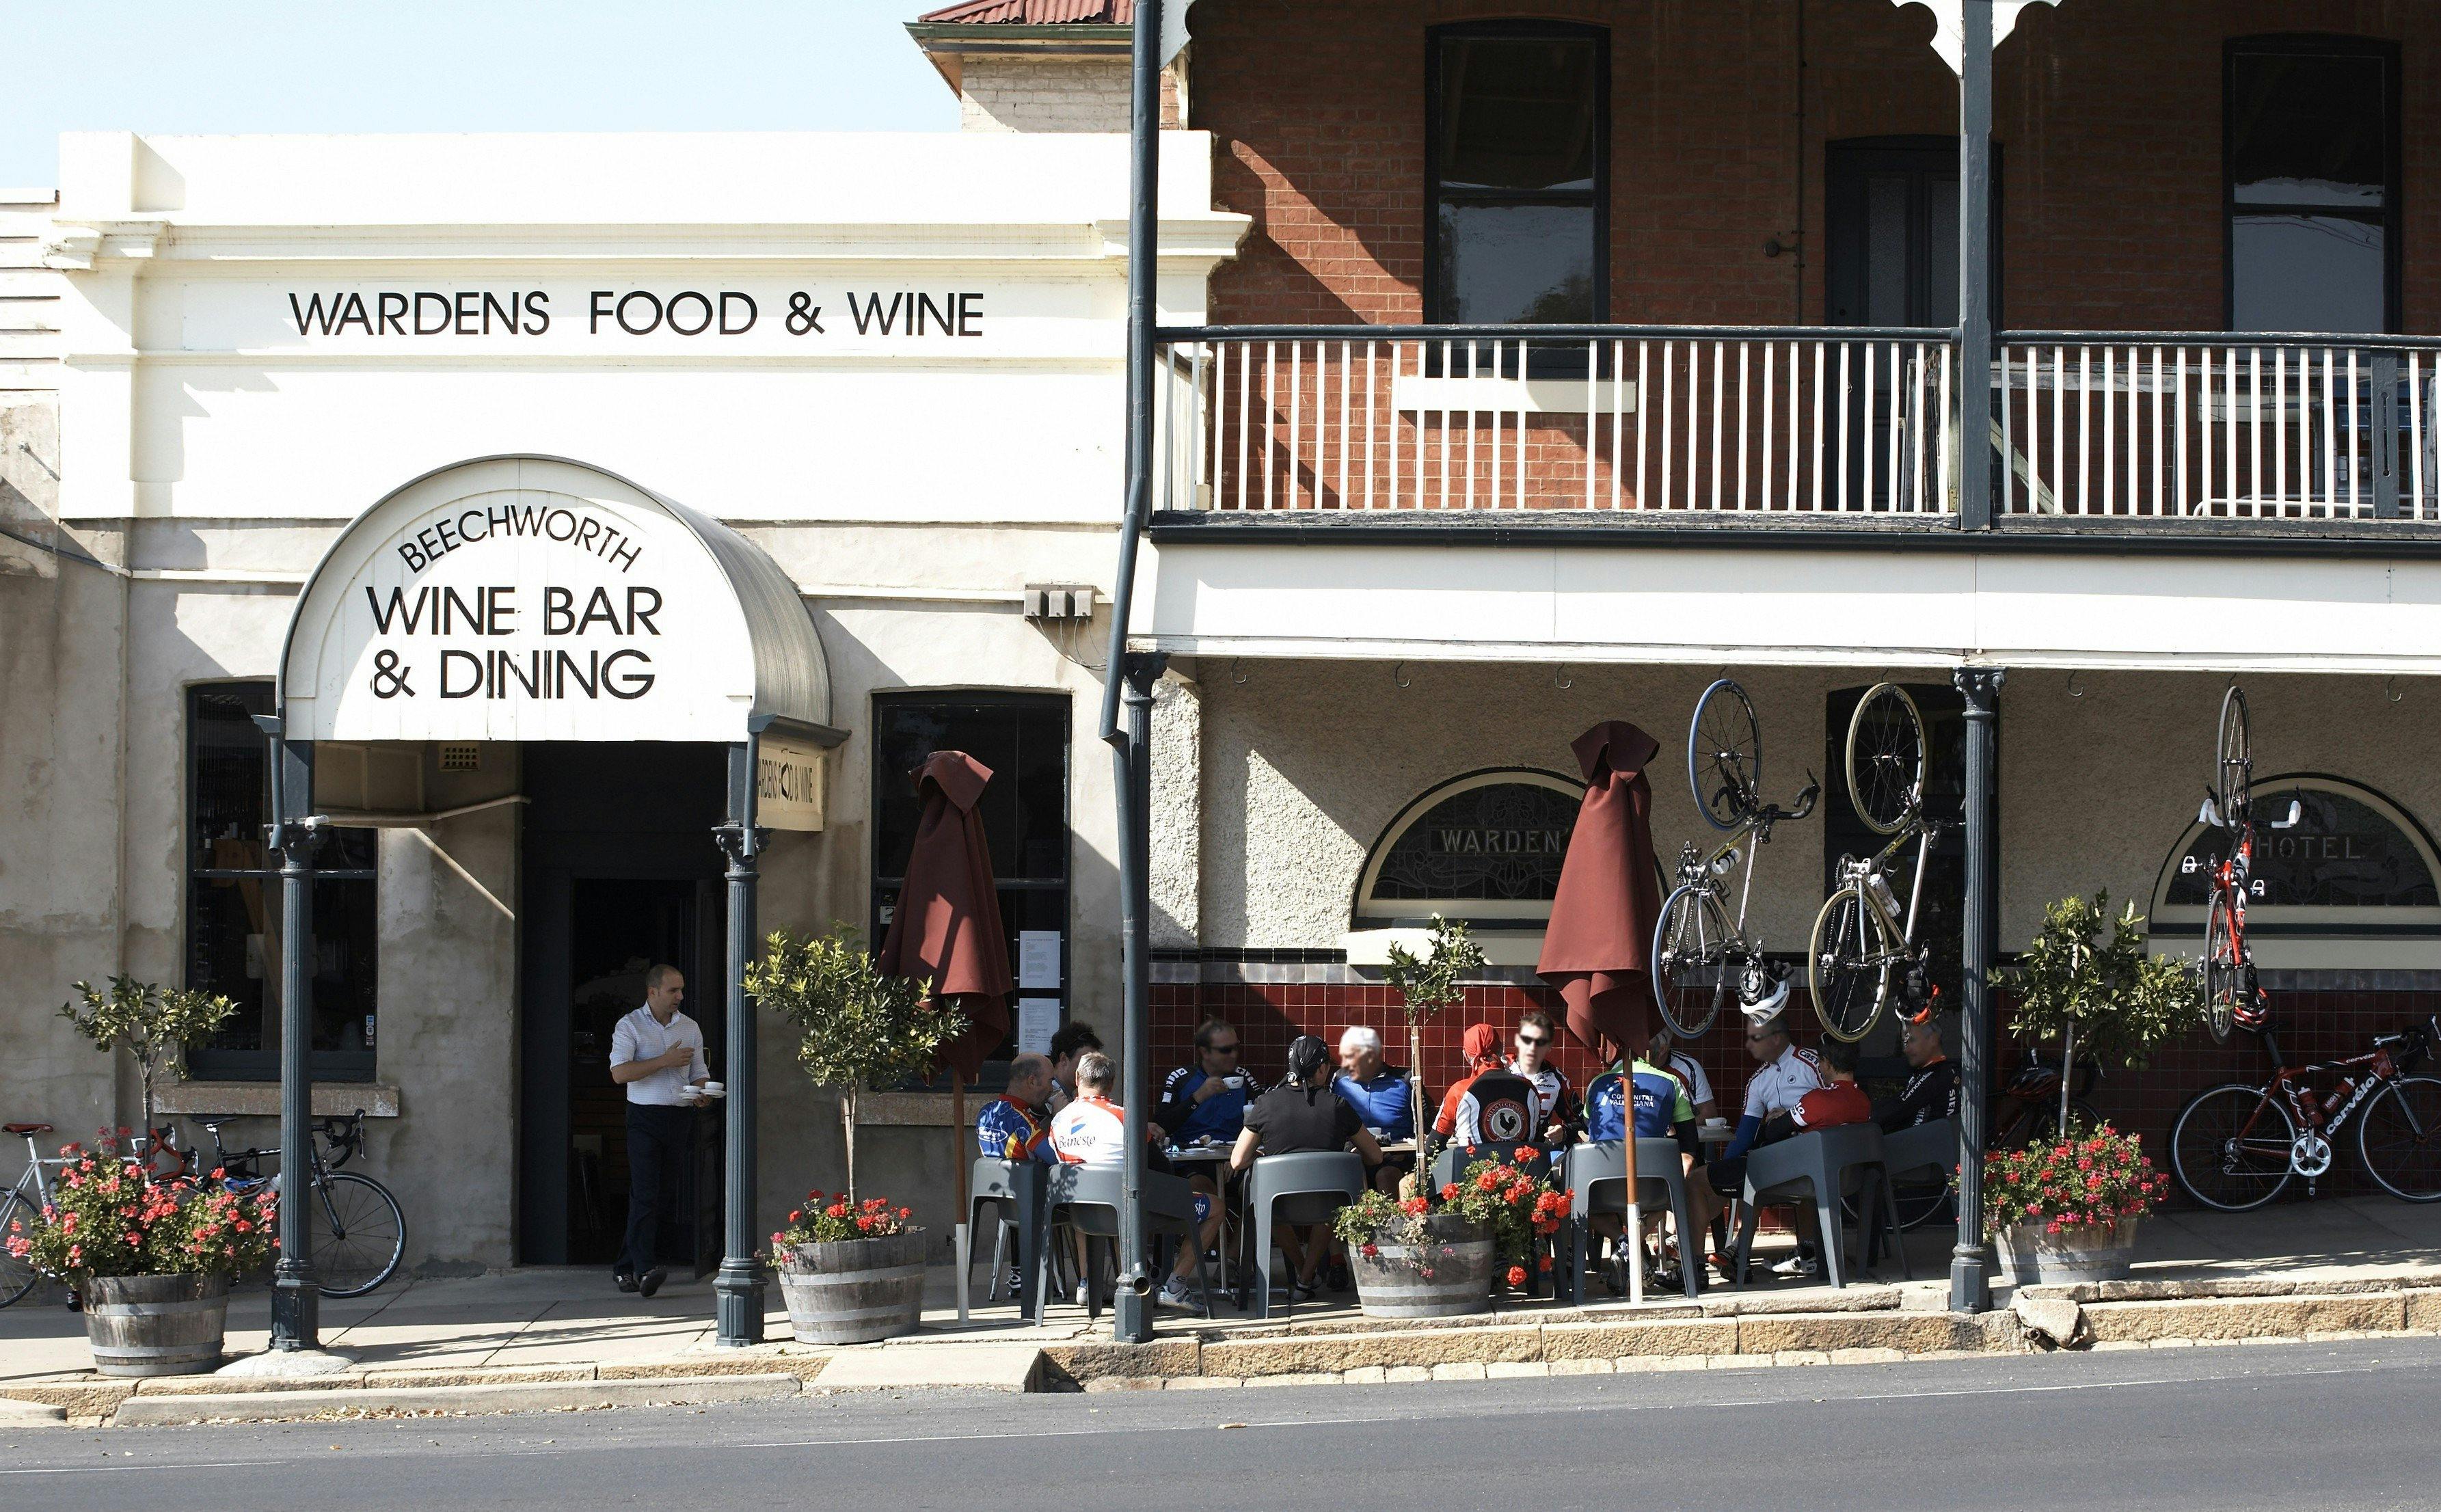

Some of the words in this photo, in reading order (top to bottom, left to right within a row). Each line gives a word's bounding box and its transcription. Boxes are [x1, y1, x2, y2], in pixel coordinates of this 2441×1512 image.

[288, 291, 550, 336] WARDENS
[590, 291, 757, 336] FOOD
[785, 291, 825, 336] &
[846, 292, 984, 336] WINE
[397, 504, 642, 574] BEECHWORTH
[366, 586, 515, 636] WINE
[544, 586, 663, 636] BAR
[371, 649, 416, 699] &
[441, 649, 656, 701] DINING
[758, 759, 777, 799] ARDENS
[1442, 828, 1569, 854] WARDEN'
[2256, 836, 2361, 859] HOTEL
